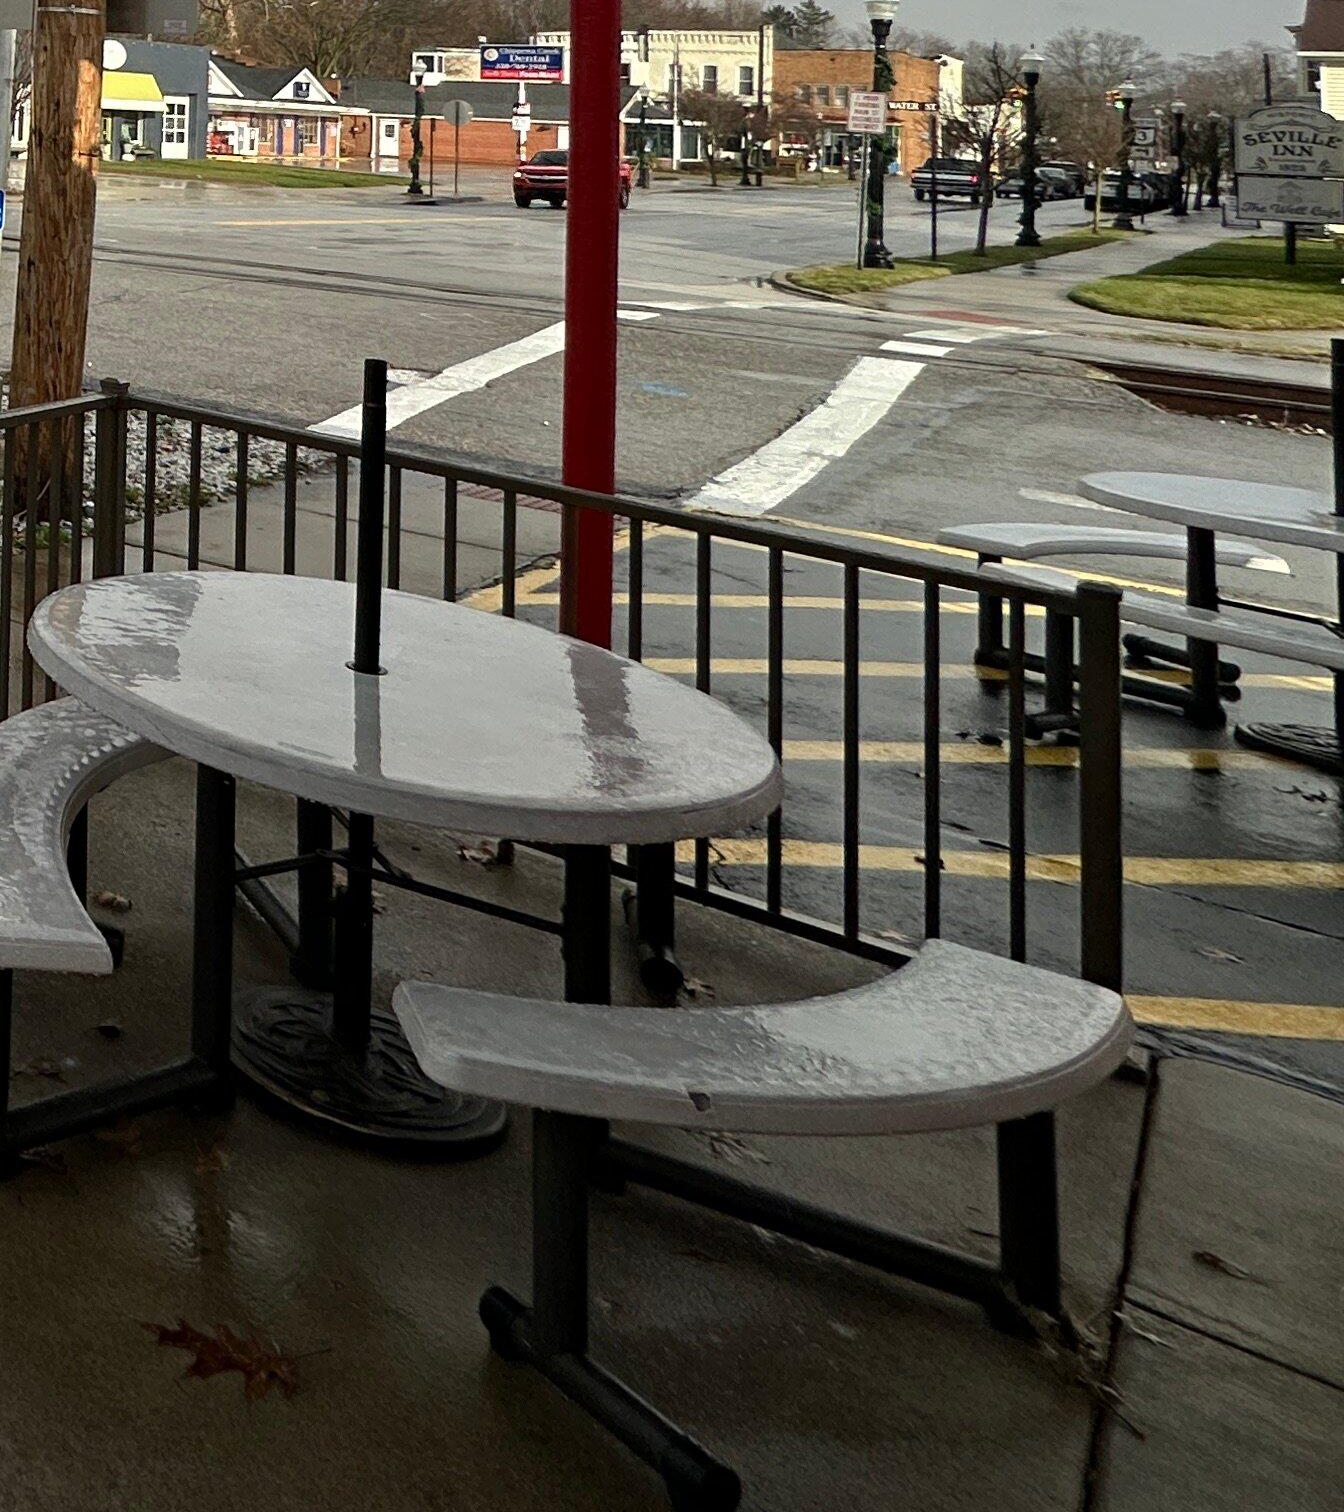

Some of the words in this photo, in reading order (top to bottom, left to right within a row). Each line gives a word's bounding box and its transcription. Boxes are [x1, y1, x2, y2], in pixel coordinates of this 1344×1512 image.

[509, 54, 552, 63] Dental
[888, 101, 919, 110] WATER
[1243, 131, 1343, 149] SEVILLE
[1272, 144, 1313, 157] INN
